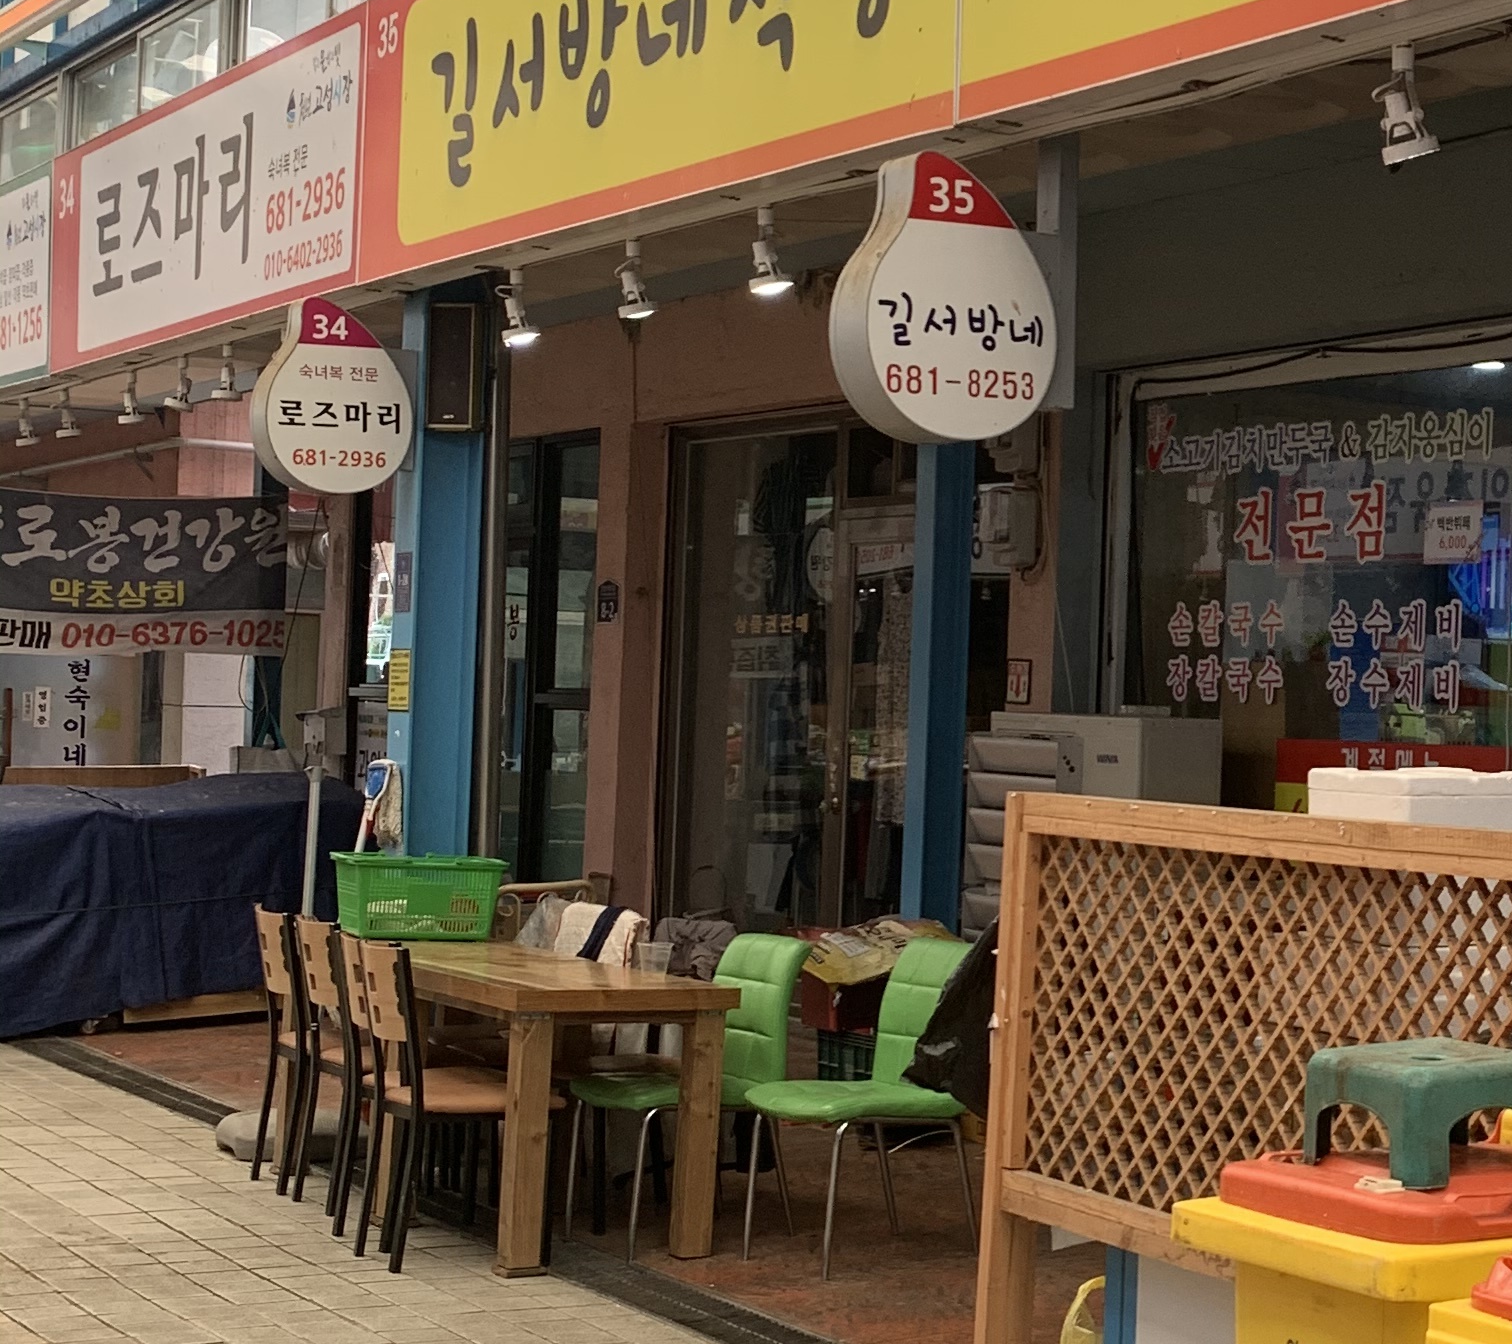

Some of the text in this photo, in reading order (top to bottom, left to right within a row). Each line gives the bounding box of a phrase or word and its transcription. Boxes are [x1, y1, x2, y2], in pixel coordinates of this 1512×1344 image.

[377, 12, 400, 59] 35
[58, 174, 75, 220] 34
[92, 111, 256, 299] 로즈마리
[266, 166, 347, 235] 681-2936
[928, 176, 976, 216] 35
[264, 229, 344, 282] 010-6402-2936
[312, 314, 349, 342] 34
[877, 291, 1045, 353] 길서방네
[298, 362, 380, 384] 숙녀복 전문
[885, 362, 1036, 403] 681-8253
[278, 398, 403, 436] 로즈마리
[292, 448, 388, 470] 681-2936
[1160, 420, 1334, 476] 소고기김치만두국
[1339, 423, 1362, 460] &
[1366, 407, 1494, 464] 감자옹심이
[0, 504, 289, 574] 로봉건강원
[1233, 479, 1388, 565] 전문점
[1438, 534, 1468, 551] 6,000
[50, 577, 186, 609] 약초상회
[61, 619, 286, 650] 010-6376-1025
[1167, 599, 1464, 654] 손칼국수 손수제비
[1165, 654, 1463, 714] 장칼국수 장수제비
[63, 658, 91, 768] 현숙이네
